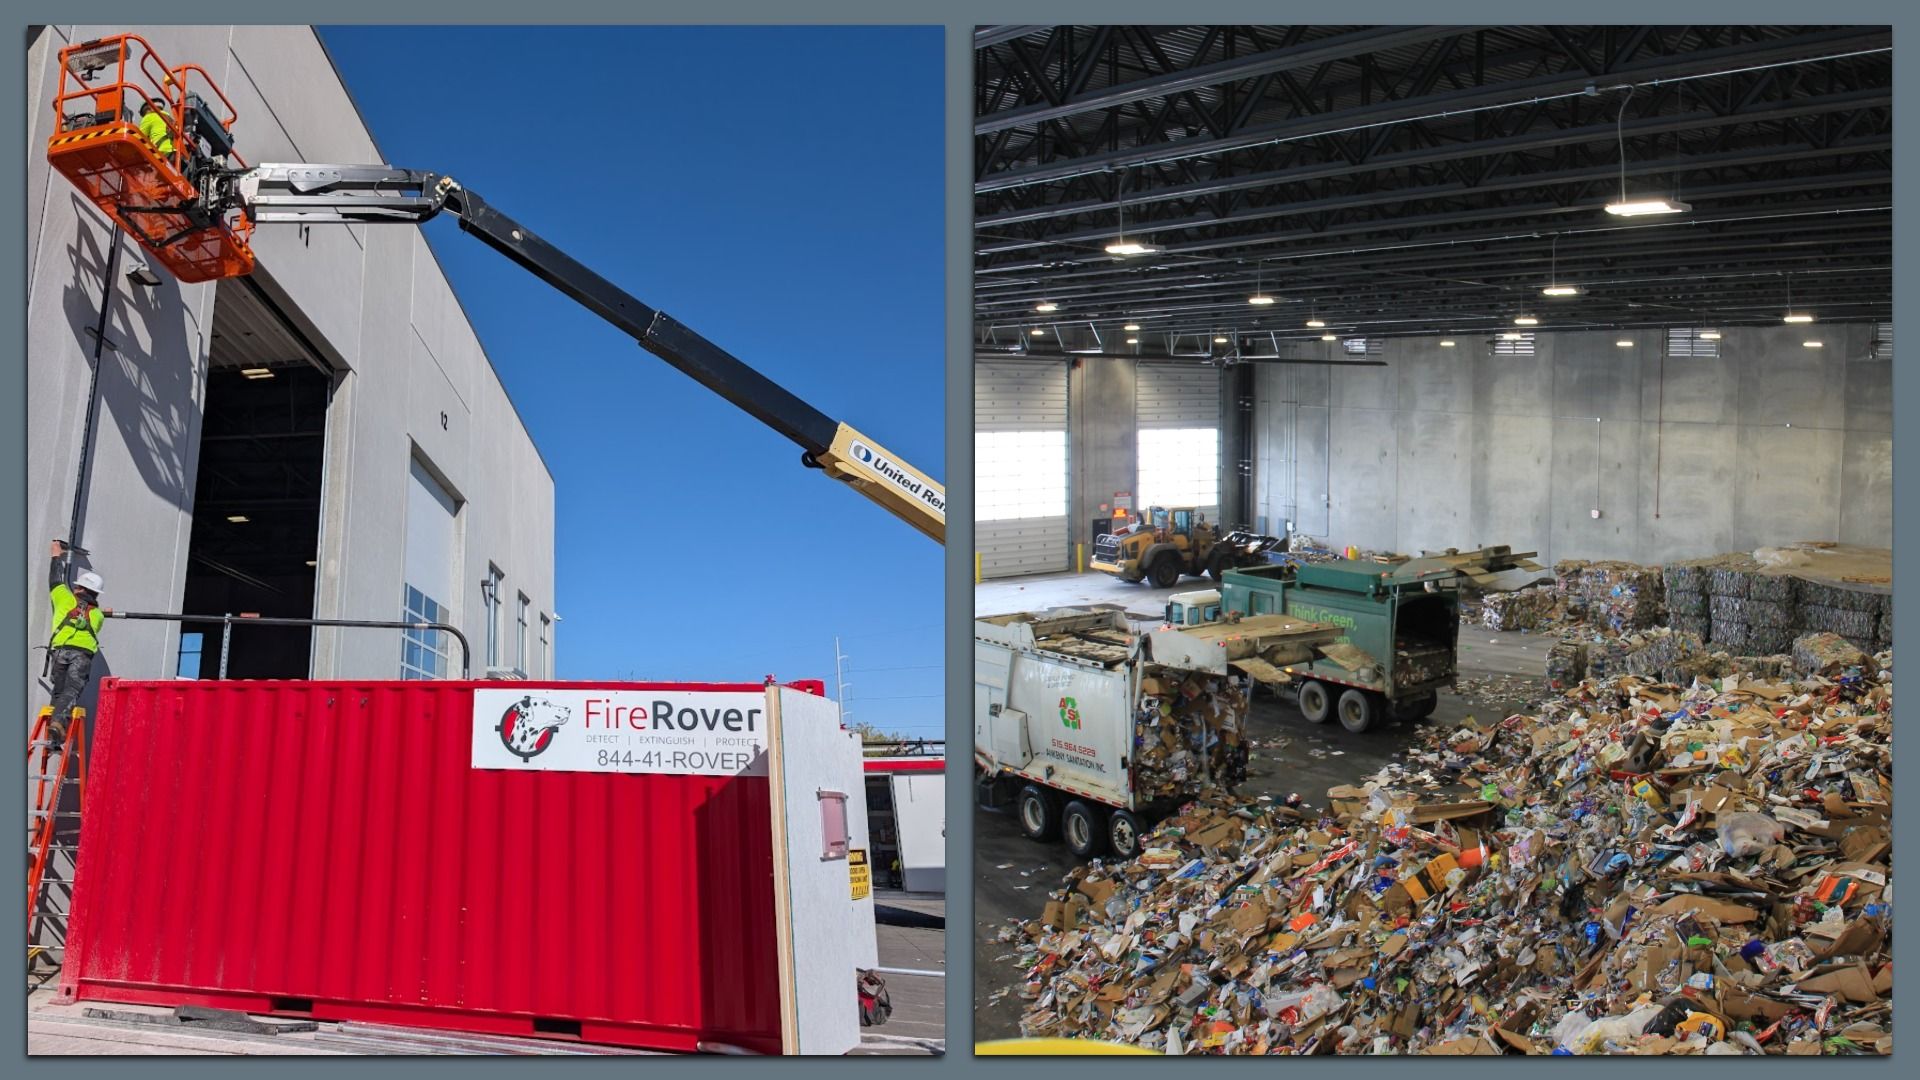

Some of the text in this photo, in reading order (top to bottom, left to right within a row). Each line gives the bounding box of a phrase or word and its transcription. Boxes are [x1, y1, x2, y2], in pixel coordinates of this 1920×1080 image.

[440, 410, 448, 431] 12
[874, 458, 921, 494] United
[1288, 604, 1358, 631] Think Green,
[585, 699, 761, 732] FireRover
[585, 734, 759, 747] DETECT EXTINGUISH PROTECT
[597, 750, 752, 770] 844-41-ROVER
